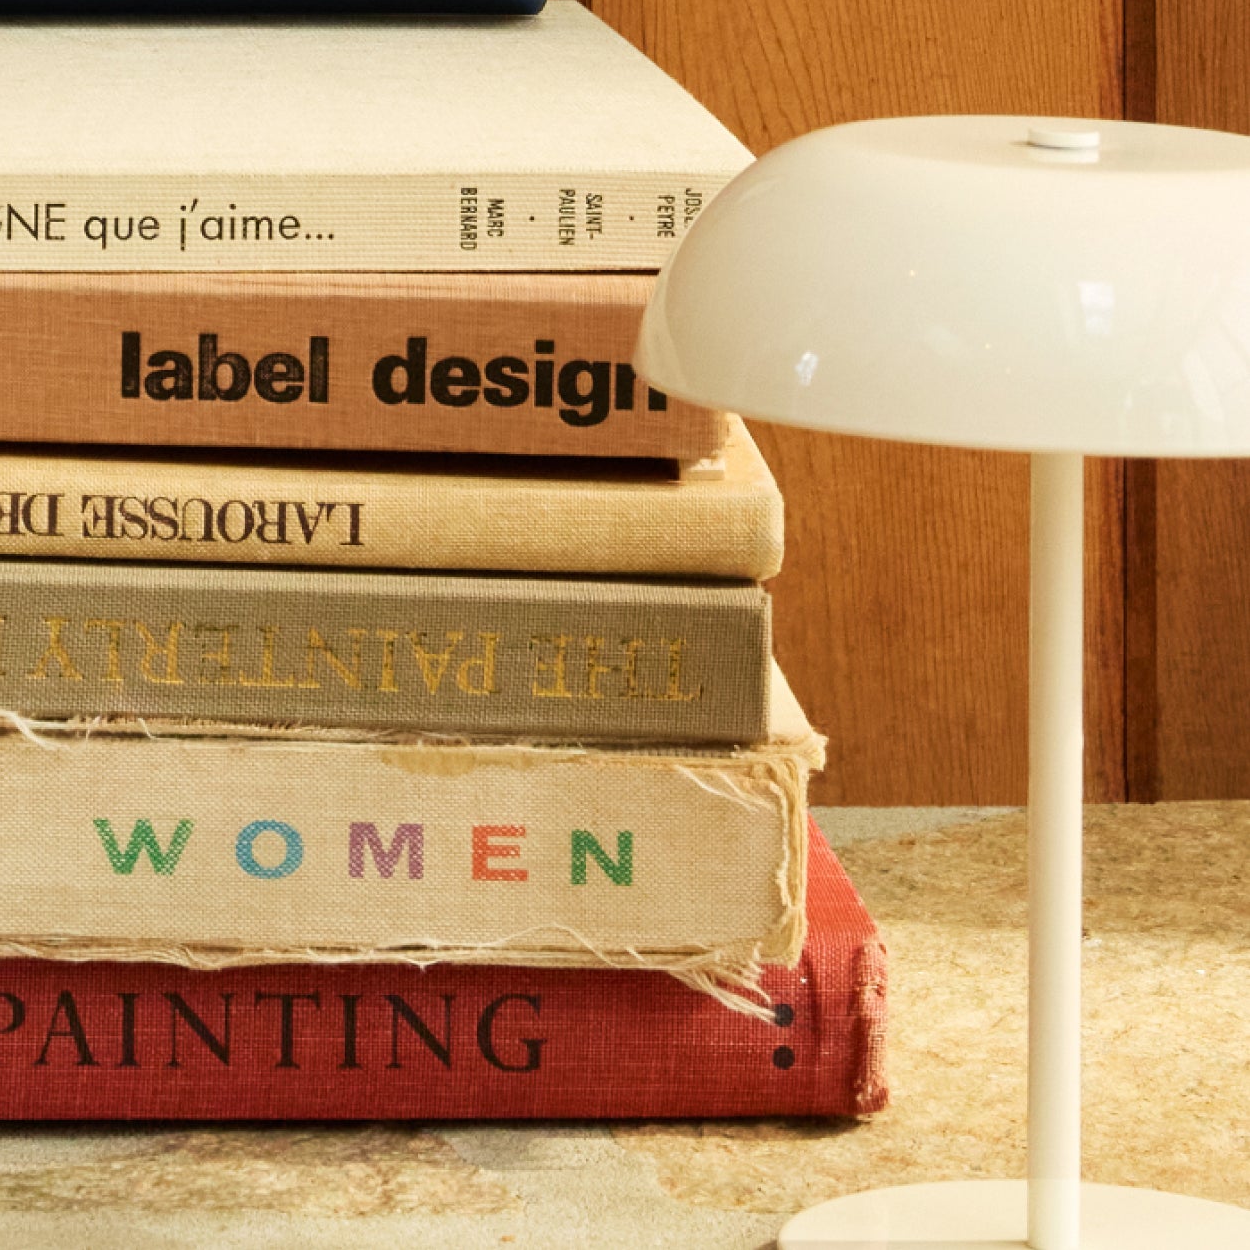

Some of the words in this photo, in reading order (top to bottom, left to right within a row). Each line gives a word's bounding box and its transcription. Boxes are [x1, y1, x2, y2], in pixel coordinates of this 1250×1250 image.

[84, 215, 160, 249] que
[460, 187, 478, 251] BERNARD
[487, 198, 504, 237] MARC
[558, 188, 576, 246] PAULIEN
[656, 194, 676, 239] PEYRE
[121, 331, 330, 405] label
[372, 337, 669, 428] design
[82, 495, 364, 546] LAROUSSE
[28, 612, 502, 696] PAINTERLY
[530, 633, 702, 702] THE
[93, 816, 635, 887] WOMEN
